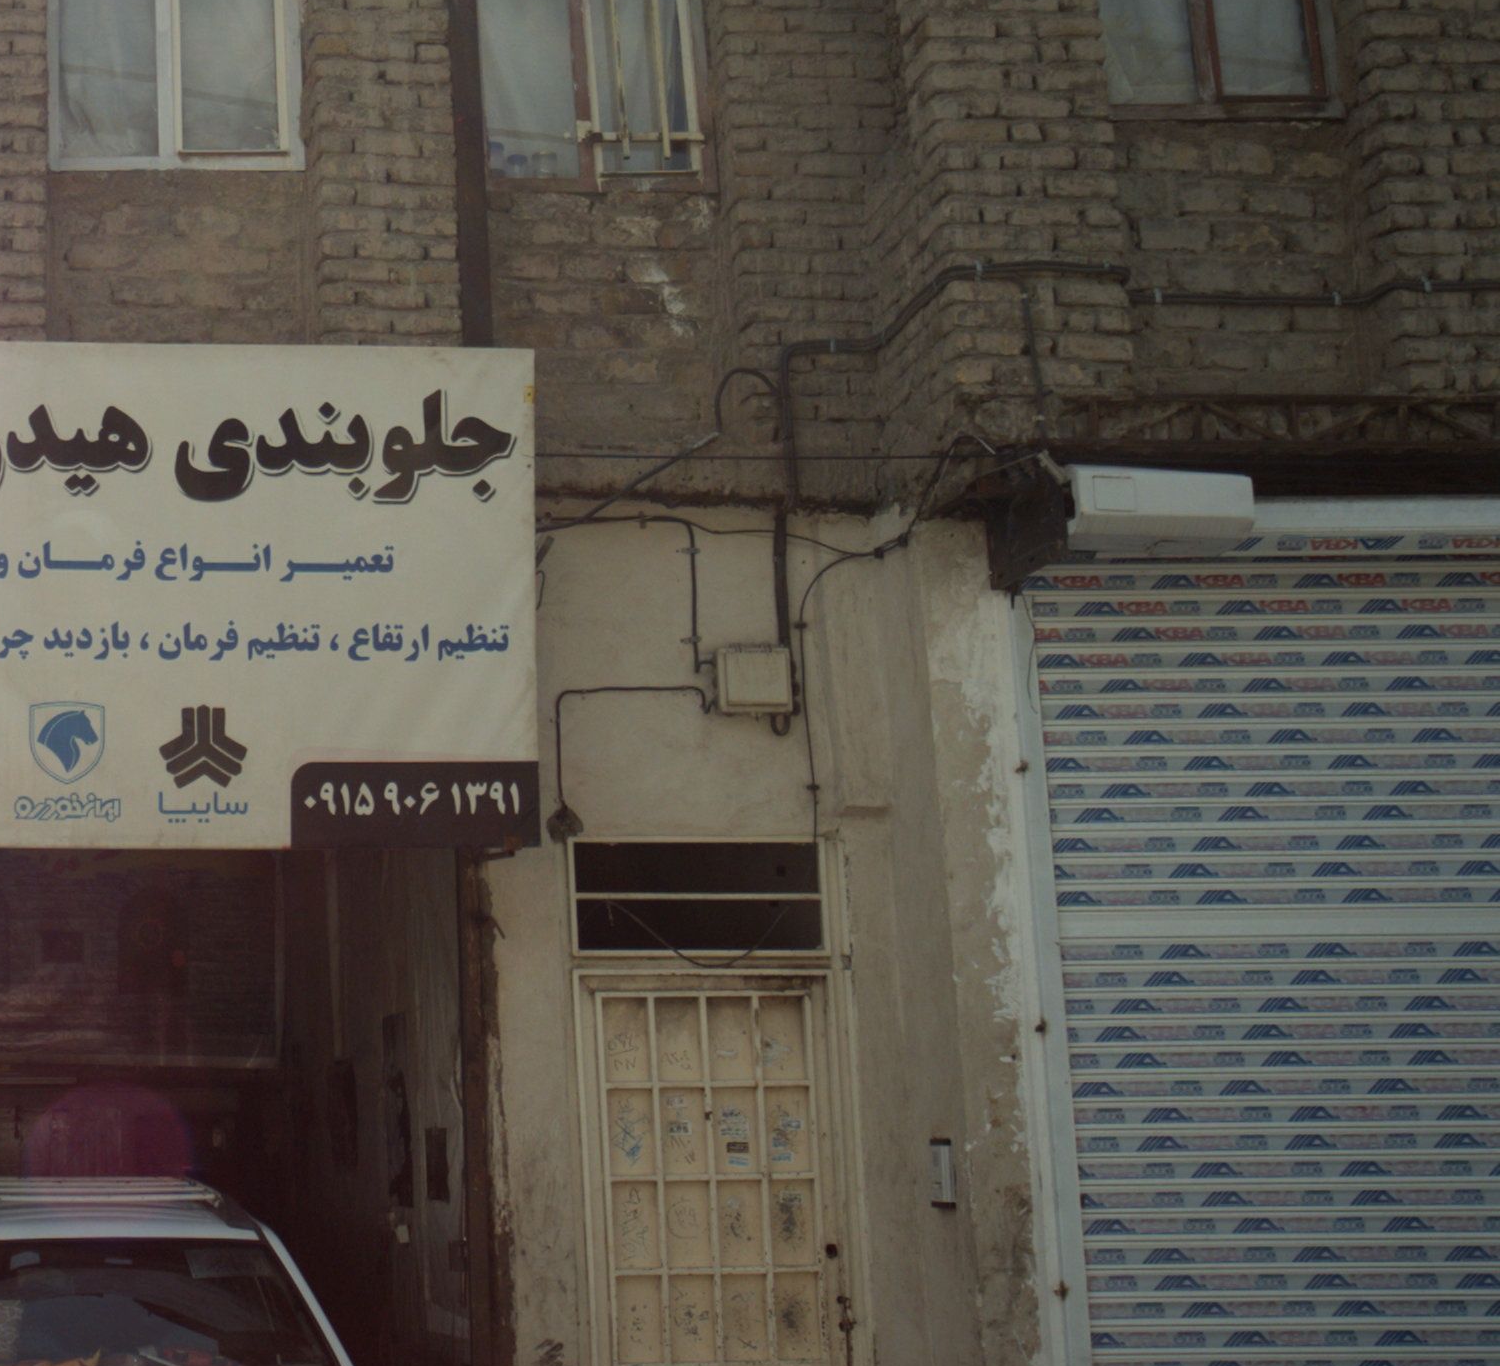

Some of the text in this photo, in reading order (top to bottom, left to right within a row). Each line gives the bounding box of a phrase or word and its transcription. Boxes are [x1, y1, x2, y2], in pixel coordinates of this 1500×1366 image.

[175, 389, 516, 503] جلوبندی
[18, 539, 146, 580] فرمان
[154, 543, 272, 582] انواع
[280, 545, 394, 582] تعمیر
[43, 621, 130, 661] بازدید
[248, 622, 320, 661] تنظیم
[438, 623, 509, 661] تنظیم
[157, 791, 248, 824] سایپا
[303, 781, 522, 816] ۰۹۱۵ ۹۰۶ ۱۳۹۱
